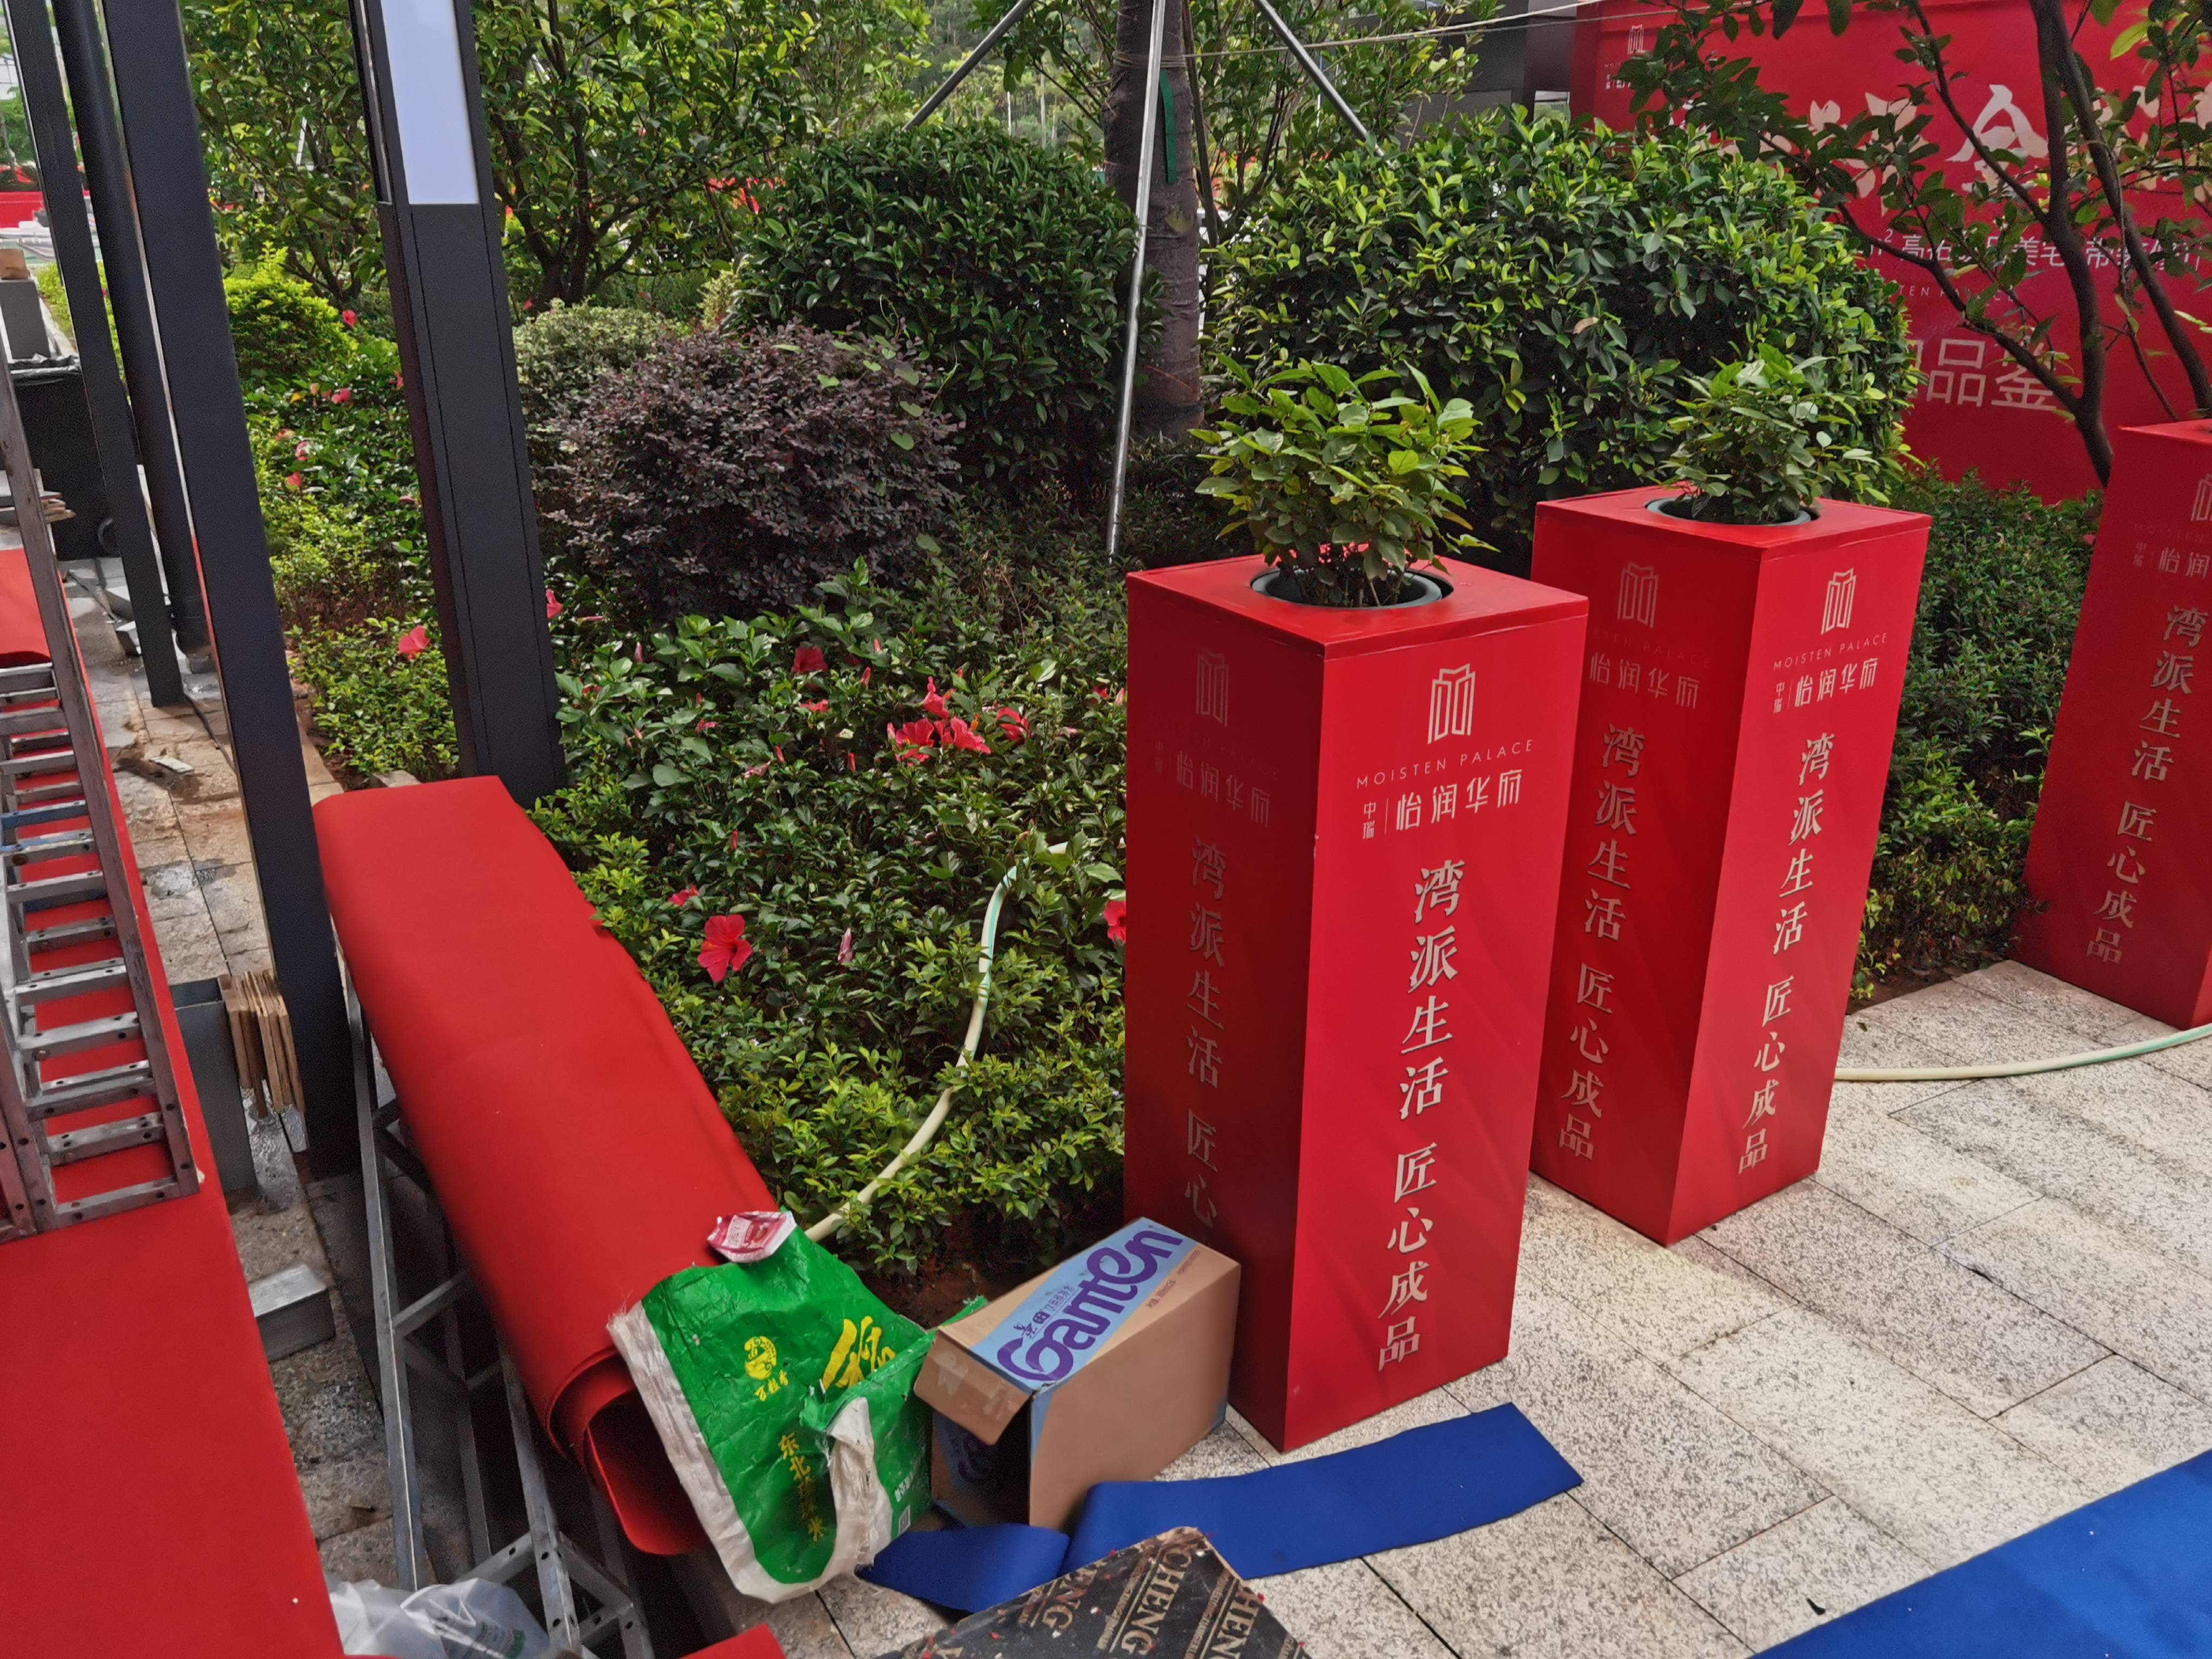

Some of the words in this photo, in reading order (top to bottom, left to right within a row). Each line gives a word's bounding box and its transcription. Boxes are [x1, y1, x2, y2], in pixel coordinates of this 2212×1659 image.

[1589, 652, 1700, 710] 怡润华府
[1773, 647, 1832, 671] MOISTEN
[1839, 632, 1887, 653] PALACE
[1794, 656, 1878, 707] 怡润华府
[2132, 604, 2208, 781] 湾派生活
[1357, 758, 1447, 789] MOISTEN
[1460, 739, 1533, 766] PALACE
[1396, 768, 1522, 831] 怡润华府
[1584, 723, 1645, 941] 湾派生活
[1773, 732, 1835, 955] 湾派生活
[2087, 800, 2157, 964] 匠心成品
[1186, 834, 1226, 1089] 湾派生活
[1399, 859, 1465, 1120] 湾派生活
[1559, 962, 1615, 1161] 匠心成品
[1738, 974, 1795, 1175] 匠心成品
[1184, 1107, 1218, 1242] 匠心
[997, 1230, 1183, 1381] Ganten
[1378, 1142, 1438, 1372] 匠心成品
[1120, 1548, 1192, 1656] CHENG
[1210, 1584, 1260, 1659] HEN
